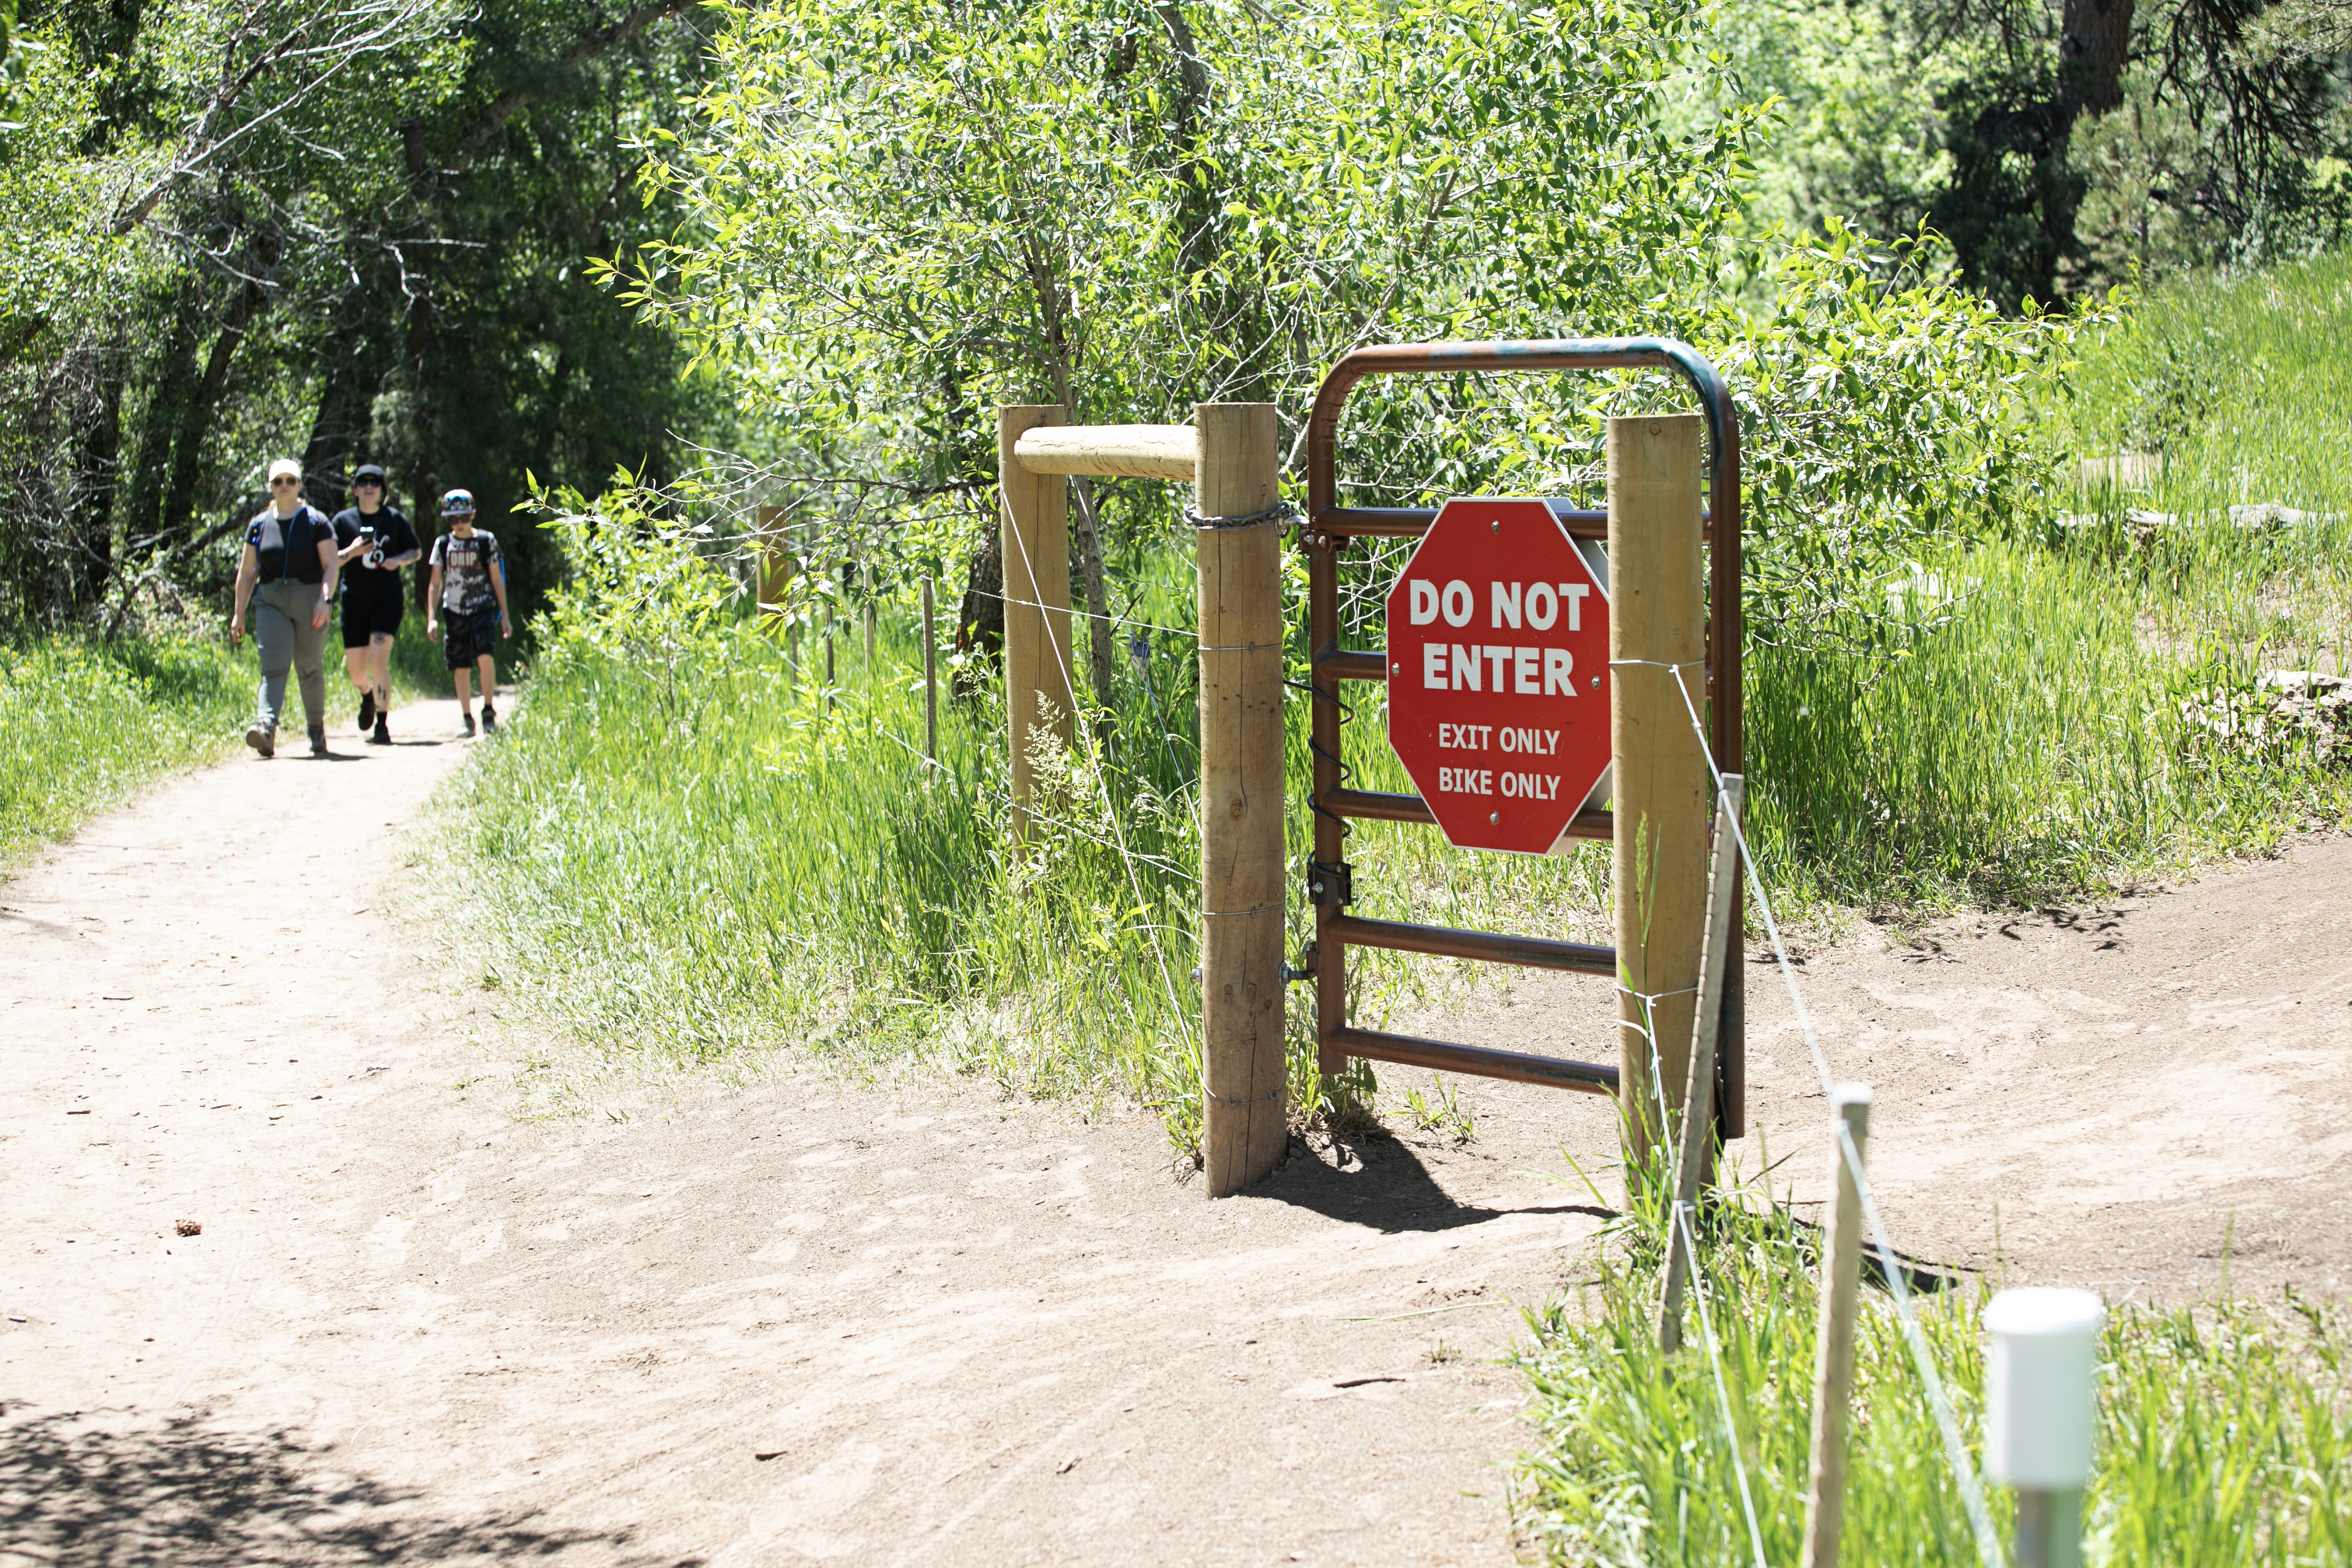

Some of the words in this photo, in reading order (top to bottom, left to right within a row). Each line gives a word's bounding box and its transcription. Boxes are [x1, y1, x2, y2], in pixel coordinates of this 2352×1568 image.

[451, 552, 477, 566] DRIP
[1410, 579, 1474, 628] DO
[1491, 581, 1589, 631] NOT
[1423, 643, 1578, 696] ENTER
[1439, 723, 1492, 750] EXIT
[1499, 727, 1560, 755] ONLY
[1439, 767, 1492, 795] BIKE
[1500, 771, 1561, 800] ONLY
